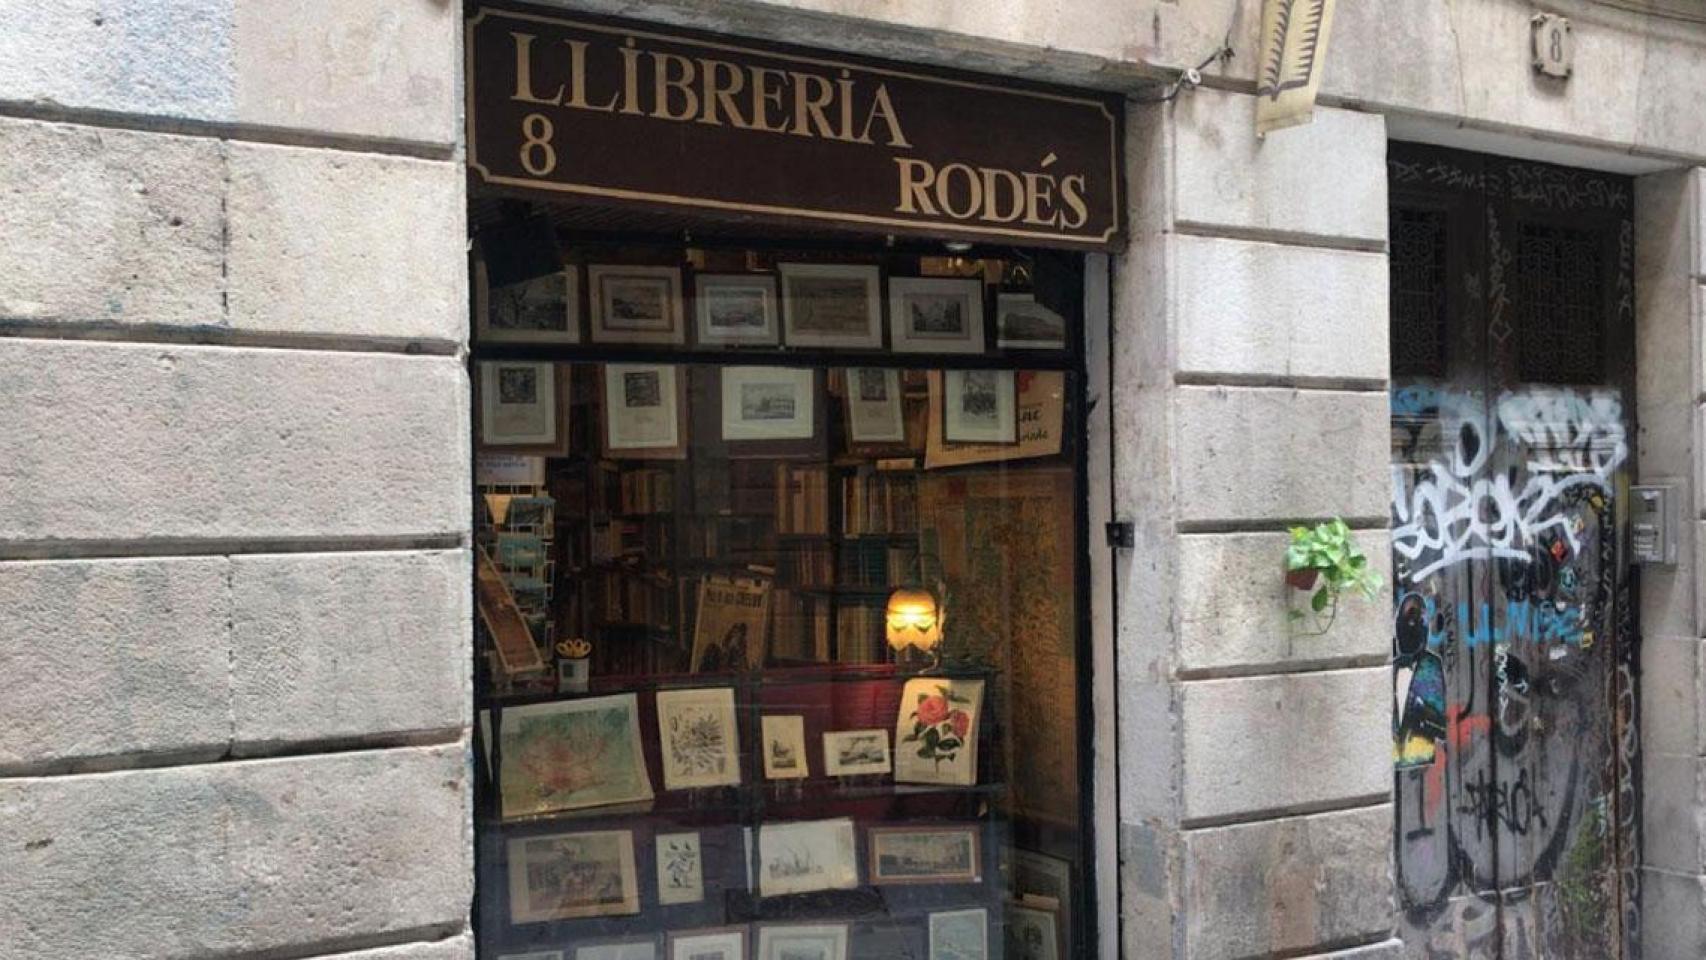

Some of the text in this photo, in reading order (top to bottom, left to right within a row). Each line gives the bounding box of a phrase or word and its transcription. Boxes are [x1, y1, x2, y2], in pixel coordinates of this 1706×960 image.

[1551, 28, 1562, 62] 8
[520, 114, 557, 176] 8
[893, 152, 1088, 230] RODÉS
